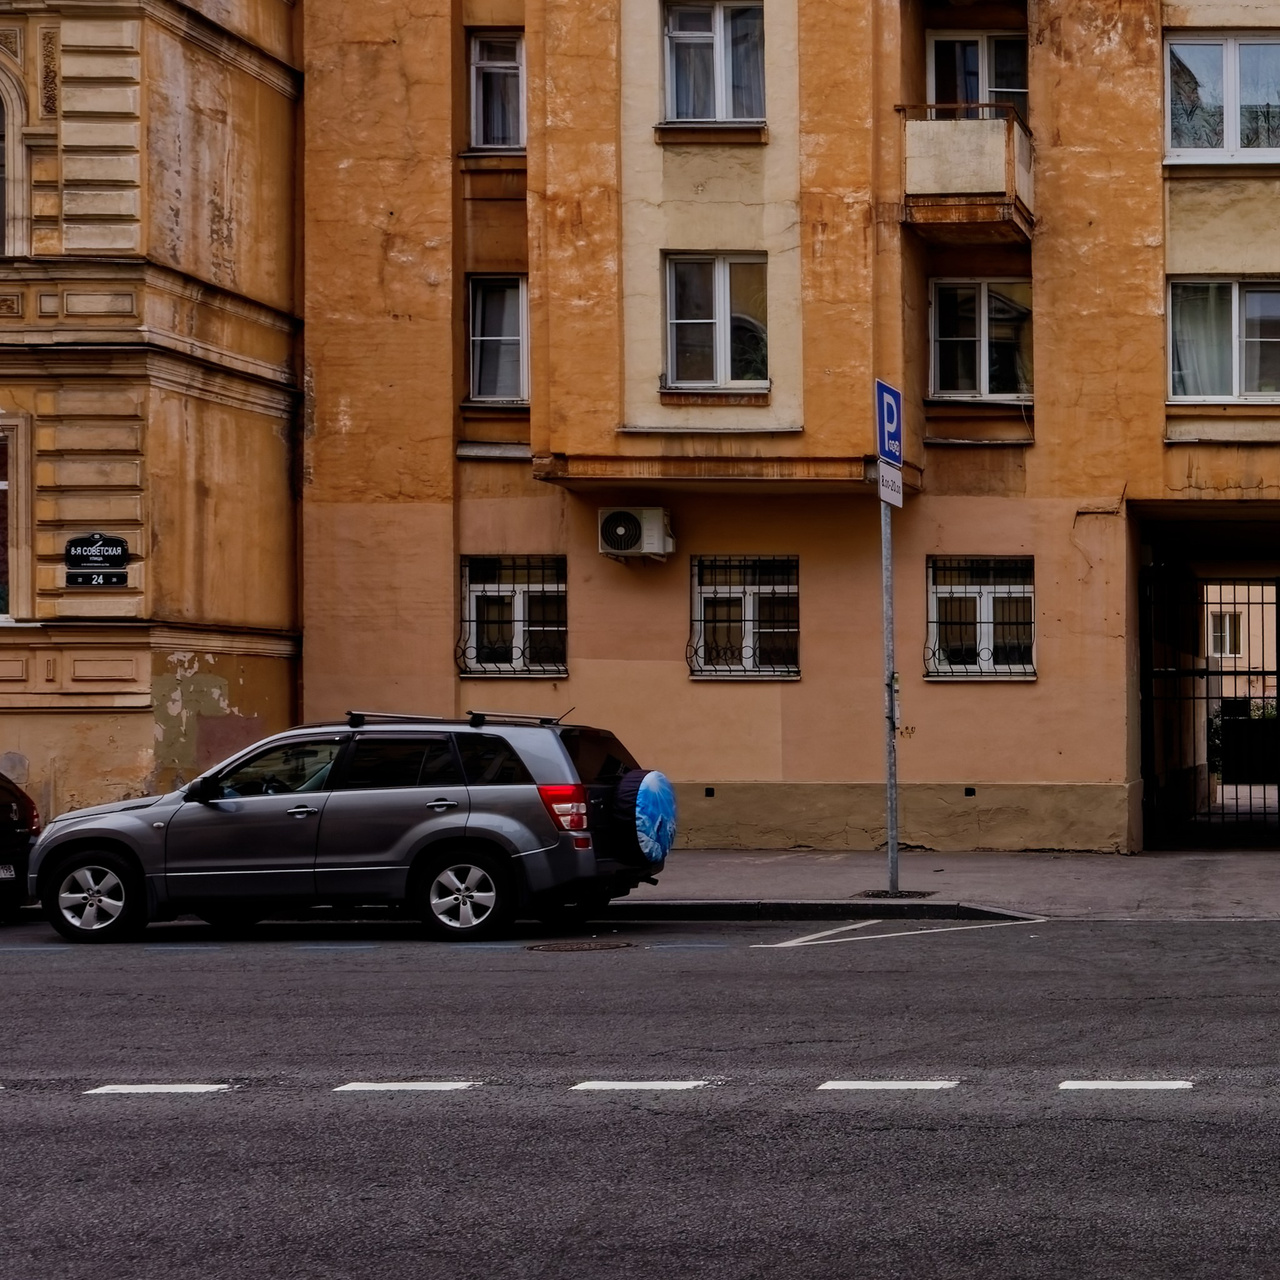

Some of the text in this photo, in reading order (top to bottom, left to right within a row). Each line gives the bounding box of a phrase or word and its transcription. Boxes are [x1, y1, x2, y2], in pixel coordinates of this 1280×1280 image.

[883, 391, 898, 452] P
[70, 546, 122, 556] 8-Я СОВЕТСКАЯ
[91, 574, 104, 585] 24
